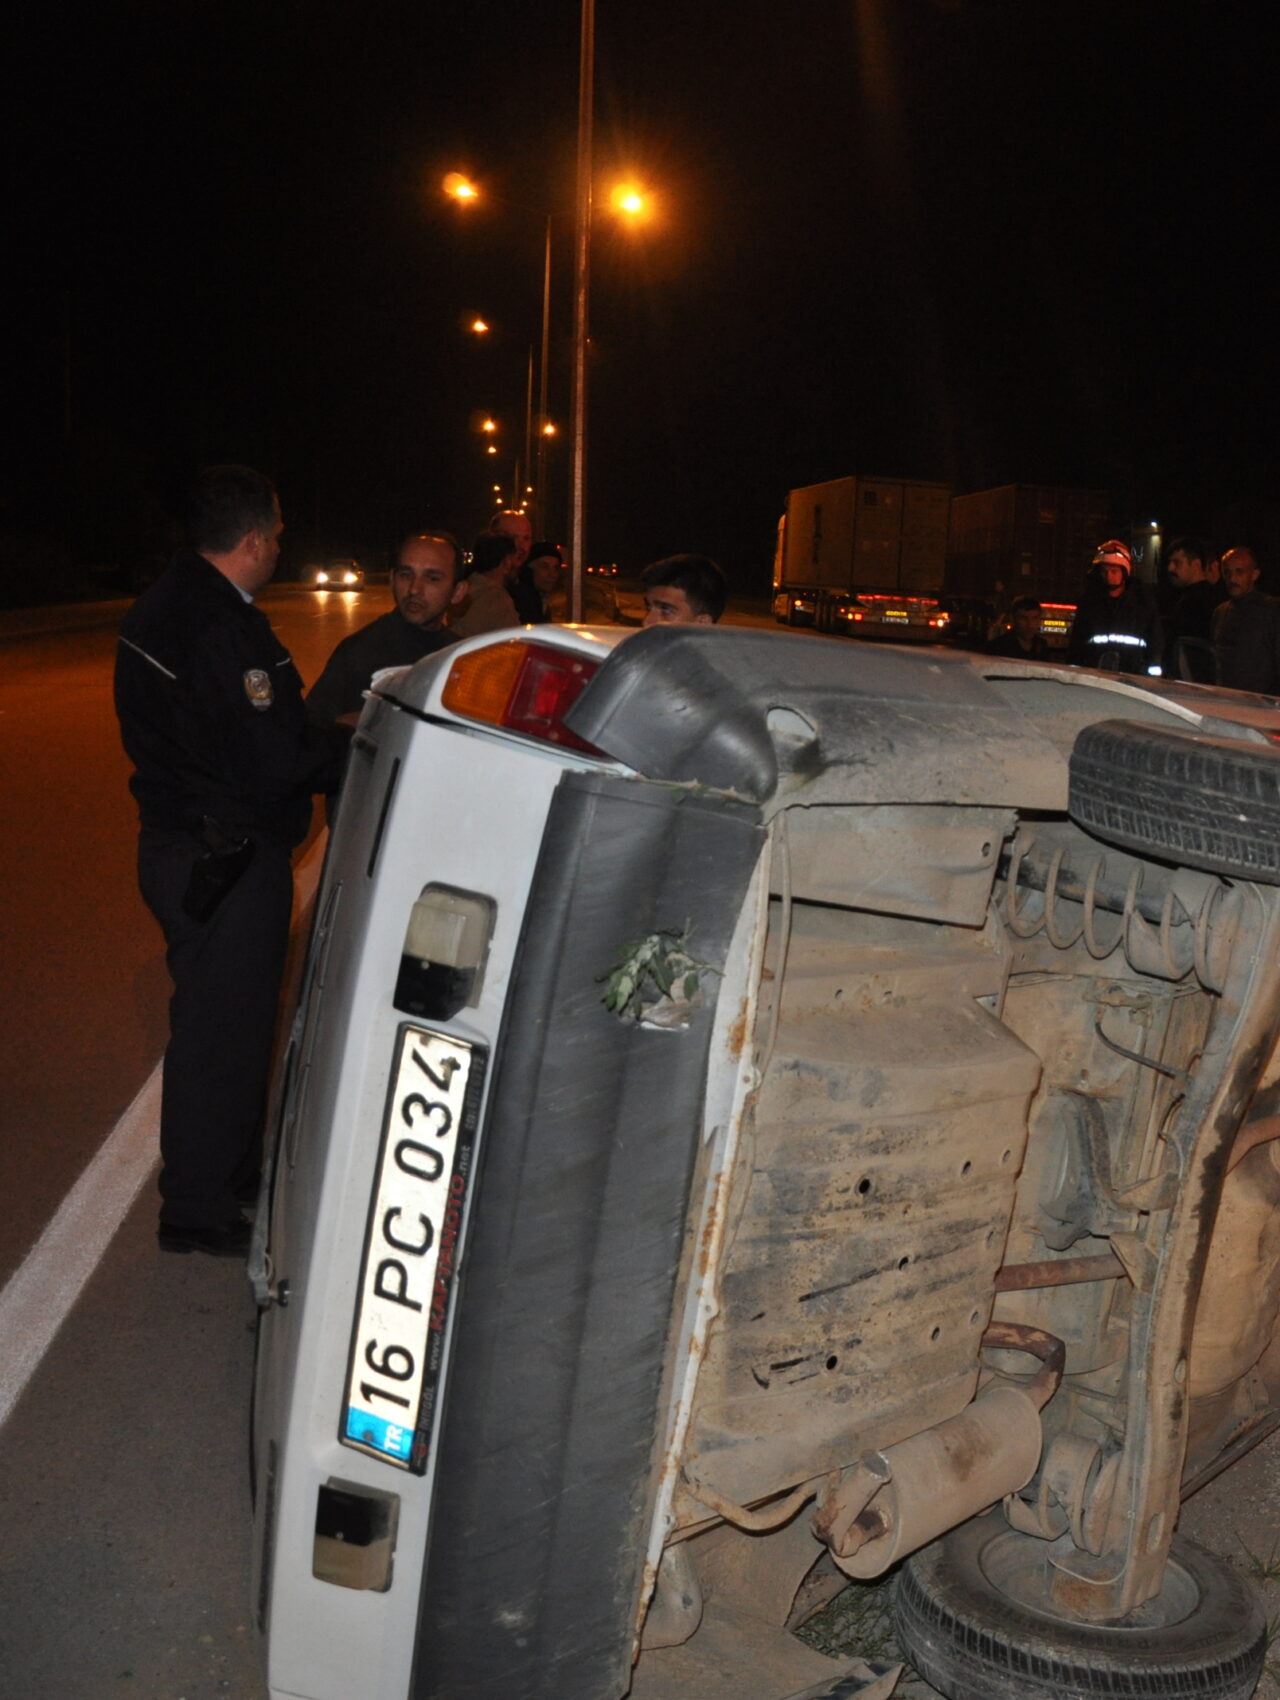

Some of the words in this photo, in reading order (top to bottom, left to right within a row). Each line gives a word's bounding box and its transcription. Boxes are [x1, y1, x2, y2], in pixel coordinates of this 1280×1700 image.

[394, 1047, 461, 1182] 034
[373, 1206, 434, 1313] PC
[360, 1338, 415, 1409] 16
[384, 1423, 405, 1451] TR
